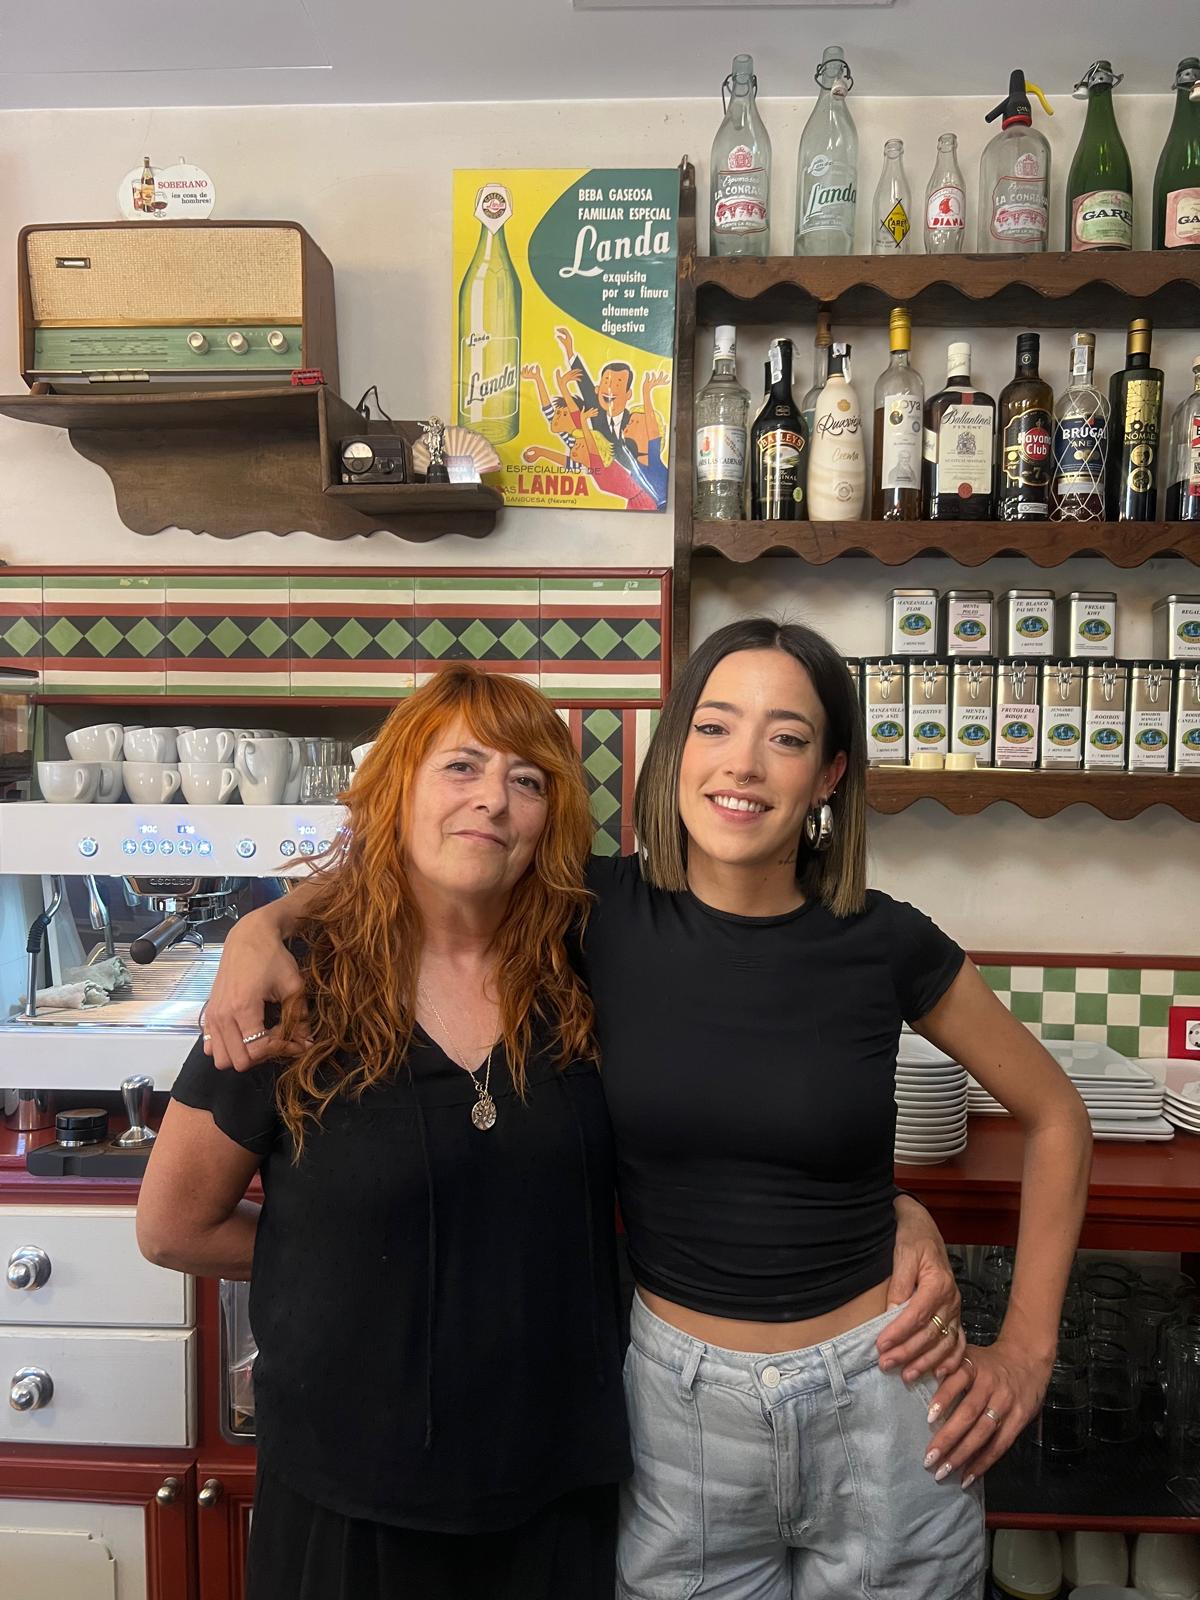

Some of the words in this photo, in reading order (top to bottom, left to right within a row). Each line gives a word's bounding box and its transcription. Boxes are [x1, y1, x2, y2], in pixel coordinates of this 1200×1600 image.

[158, 180, 208, 189] SOBERANO
[579, 189, 603, 202] BEBA
[609, 189, 652, 201] GASEOSA
[714, 190, 723, 200] LA
[996, 195, 1006, 205] LA
[804, 183, 856, 221] Landa
[578, 208, 623, 220] FAMILIAR
[629, 208, 671, 221] ESPECIAL
[933, 218, 963, 226] DIANA
[559, 221, 671, 278] Landa
[603, 270, 647, 286] exquisita
[602, 289, 619, 301] por
[624, 289, 635, 298] su
[640, 285, 669, 298] finura
[602, 303, 649, 317] altamente
[602, 319, 645, 334] digestiva
[469, 333, 490, 347] Landa
[467, 366, 515, 406] Landa
[942, 409, 992, 425] Ballantine's
[762, 432, 802, 448] BALEYS
[1063, 427, 1106, 440] BRUGAL
[1124, 430, 1156, 440] NÓMAD
[1026, 443, 1047, 455] Club
[506, 464, 582, 475] ESPECIALIDAD
[587, 466, 601, 475] DE
[1033, 467, 1040, 479] 7
[518, 475, 589, 496] LANDA
